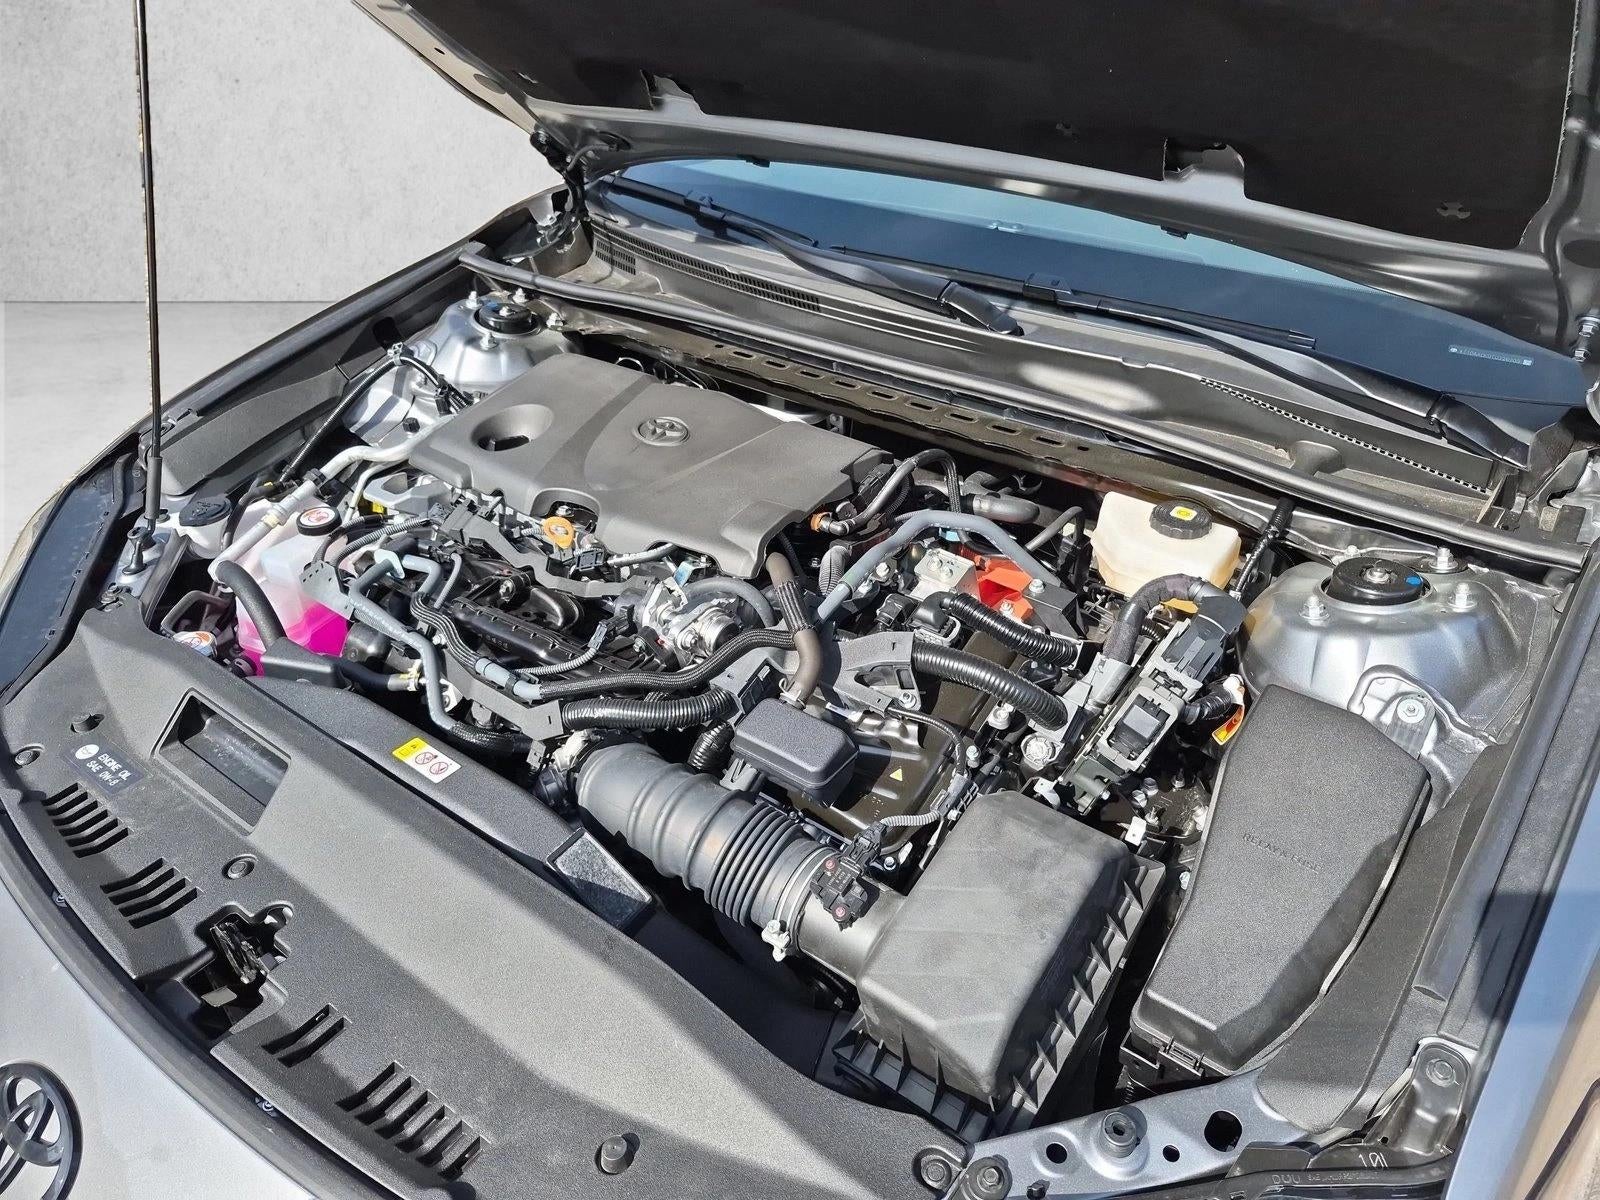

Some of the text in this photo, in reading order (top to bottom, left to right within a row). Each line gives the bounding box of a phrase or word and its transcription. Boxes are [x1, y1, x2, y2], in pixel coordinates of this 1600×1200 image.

[86, 760, 103, 773] SAE
[98, 753, 132, 781] ENGINE OIL
